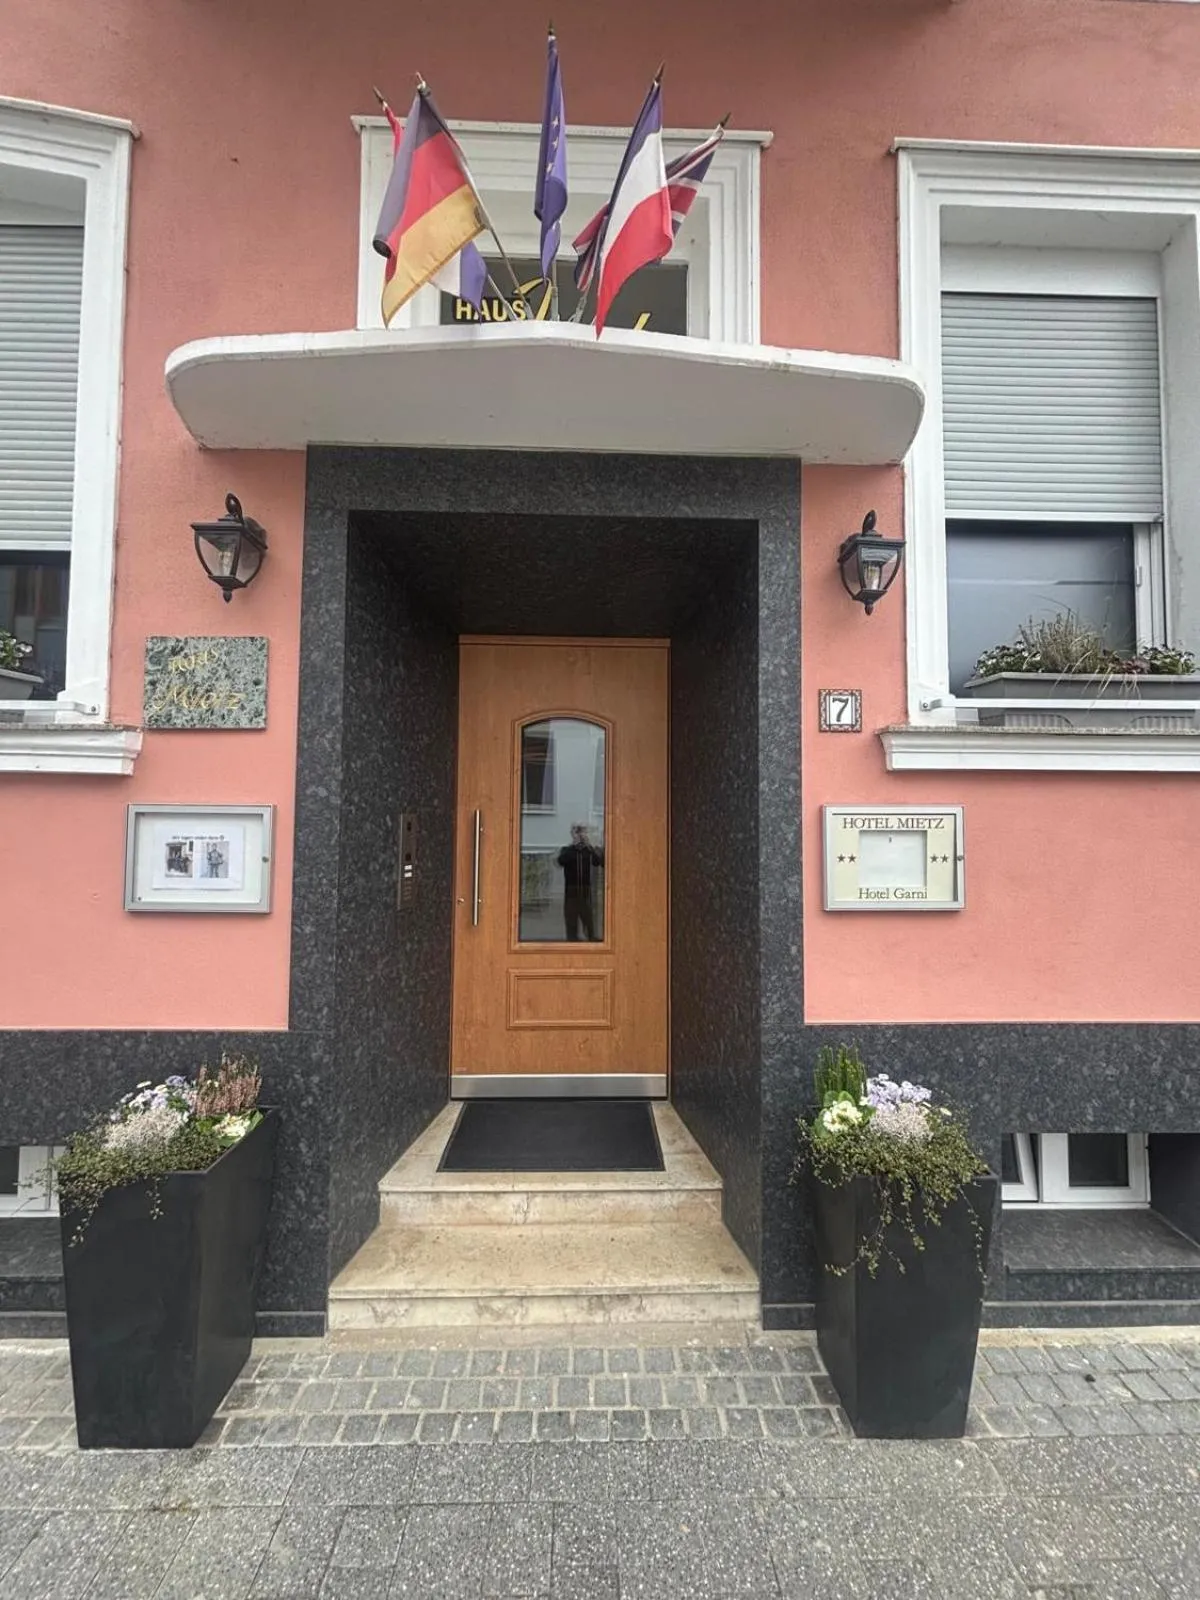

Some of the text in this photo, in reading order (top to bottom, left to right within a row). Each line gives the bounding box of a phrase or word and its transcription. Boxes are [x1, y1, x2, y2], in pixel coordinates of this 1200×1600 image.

[455, 298, 527, 321] HAUS
[831, 697, 850, 723] 7
[842, 817, 945, 830] HOTEL MIETZ
[858, 886, 928, 899] Hotel Garni
